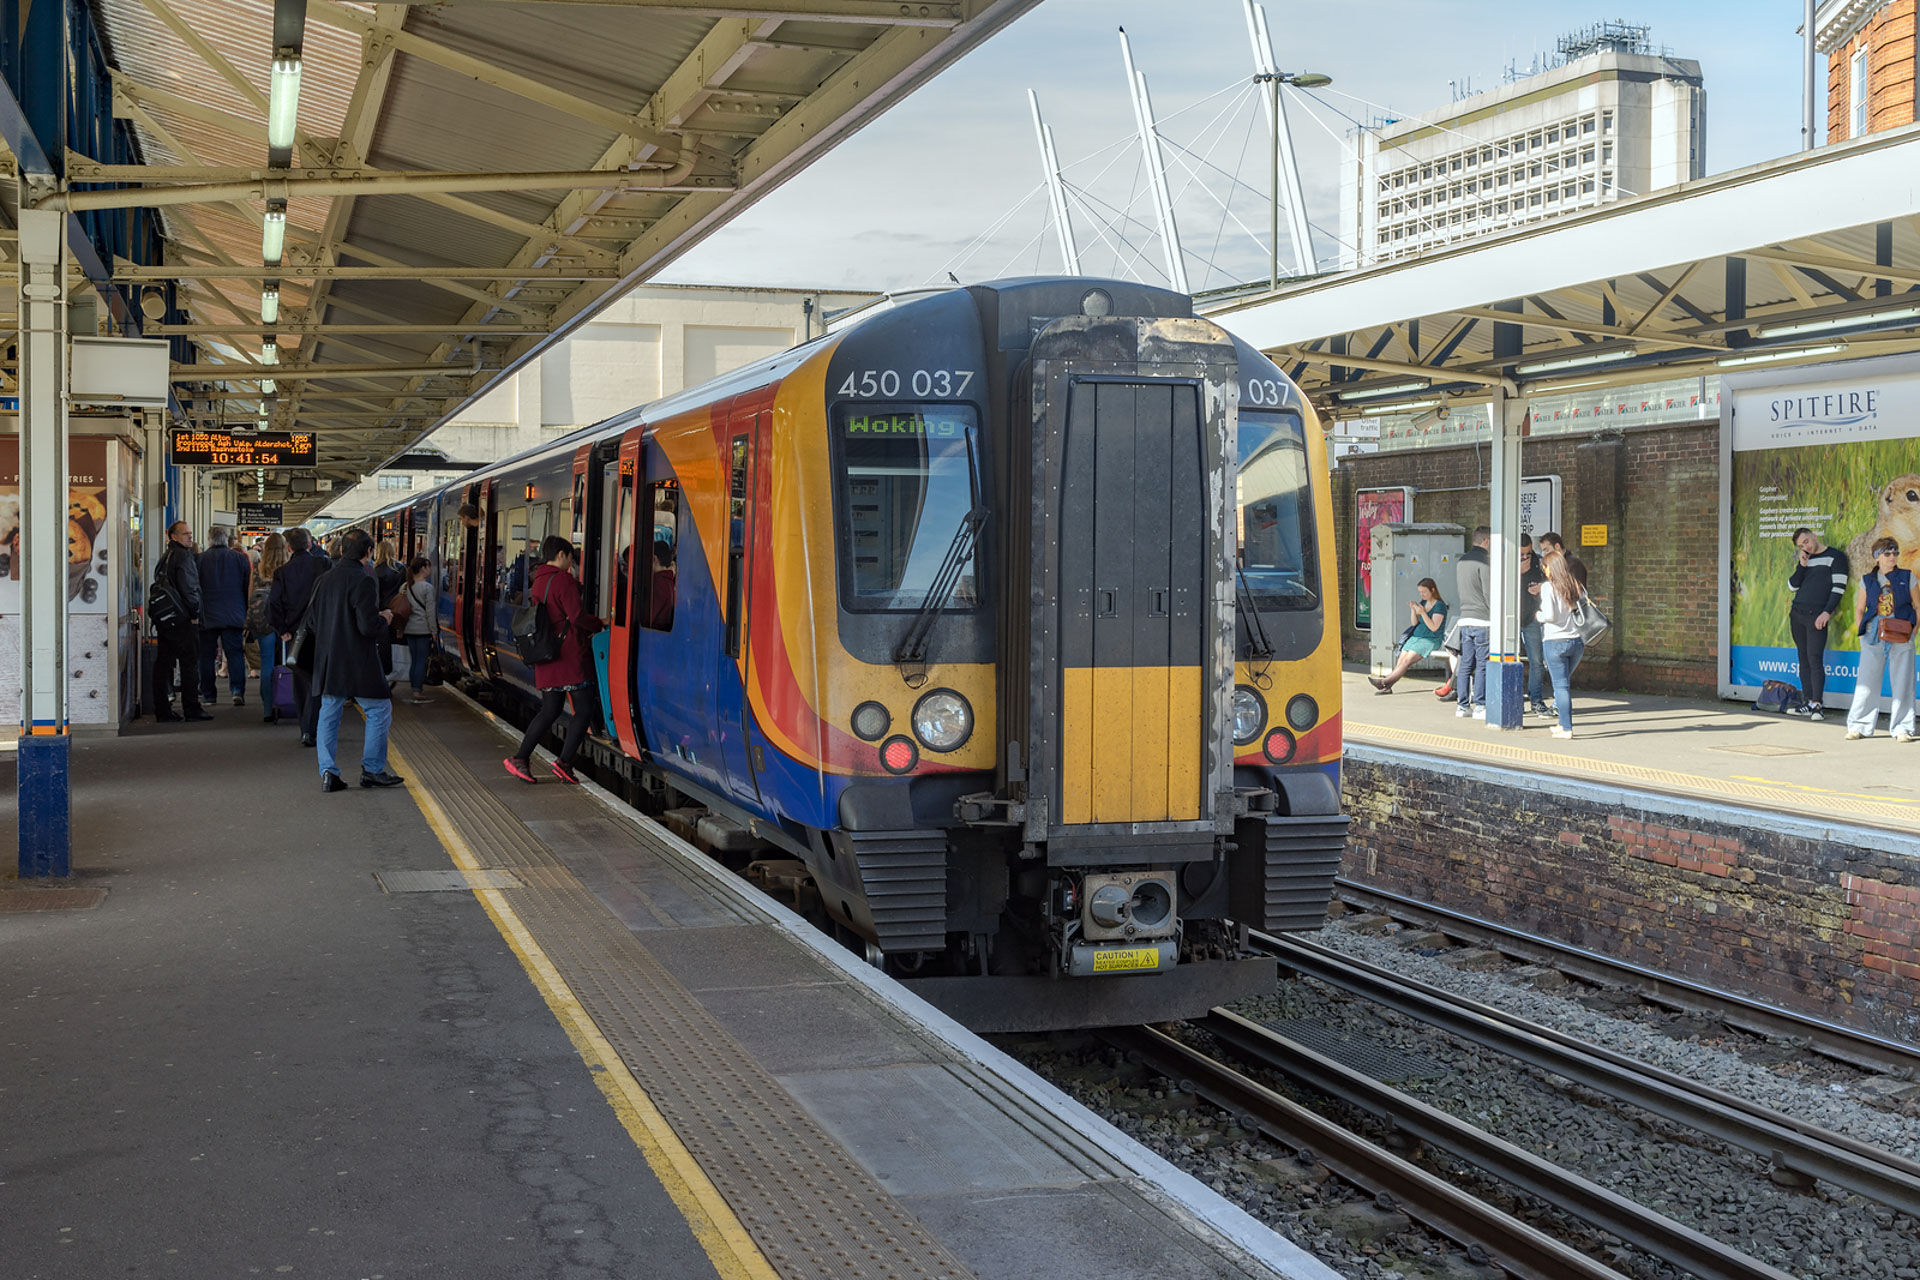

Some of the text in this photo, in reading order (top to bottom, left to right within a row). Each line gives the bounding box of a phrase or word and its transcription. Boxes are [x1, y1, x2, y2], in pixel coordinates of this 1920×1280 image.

[838, 370, 975, 397] 450 037
[1249, 378, 1289, 406] 037
[849, 416, 955, 435] Woking
[211, 453, 278, 464] 10:41:54
[1096, 951, 1134, 960] CAUTION
